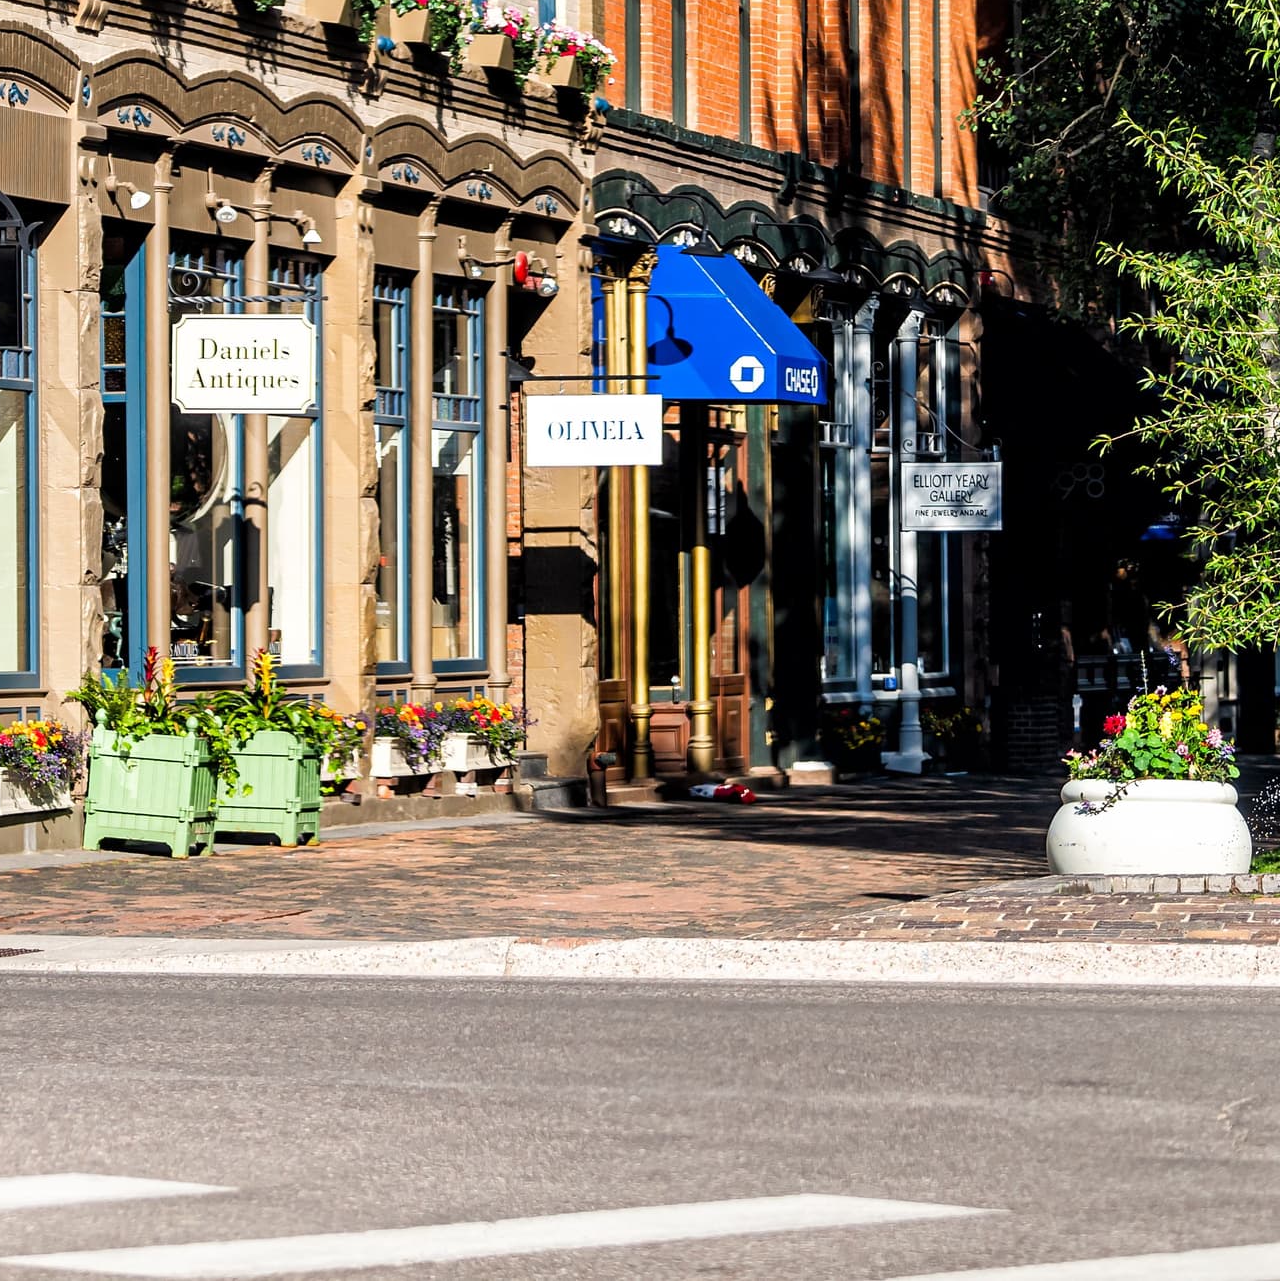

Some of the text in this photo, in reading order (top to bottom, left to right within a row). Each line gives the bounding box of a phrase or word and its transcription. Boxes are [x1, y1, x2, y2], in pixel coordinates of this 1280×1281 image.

[198, 337, 291, 361] Daniels
[187, 366, 300, 396] Antiques
[785, 367, 811, 394] CHASE
[547, 419, 645, 441] OLIVELA
[913, 473, 989, 490] ELLIOTT YEARY
[929, 490, 974, 503] GALLERY
[915, 509, 929, 517] FINE
[931, 509, 958, 517] JEWELRY
[976, 509, 988, 517] ART
